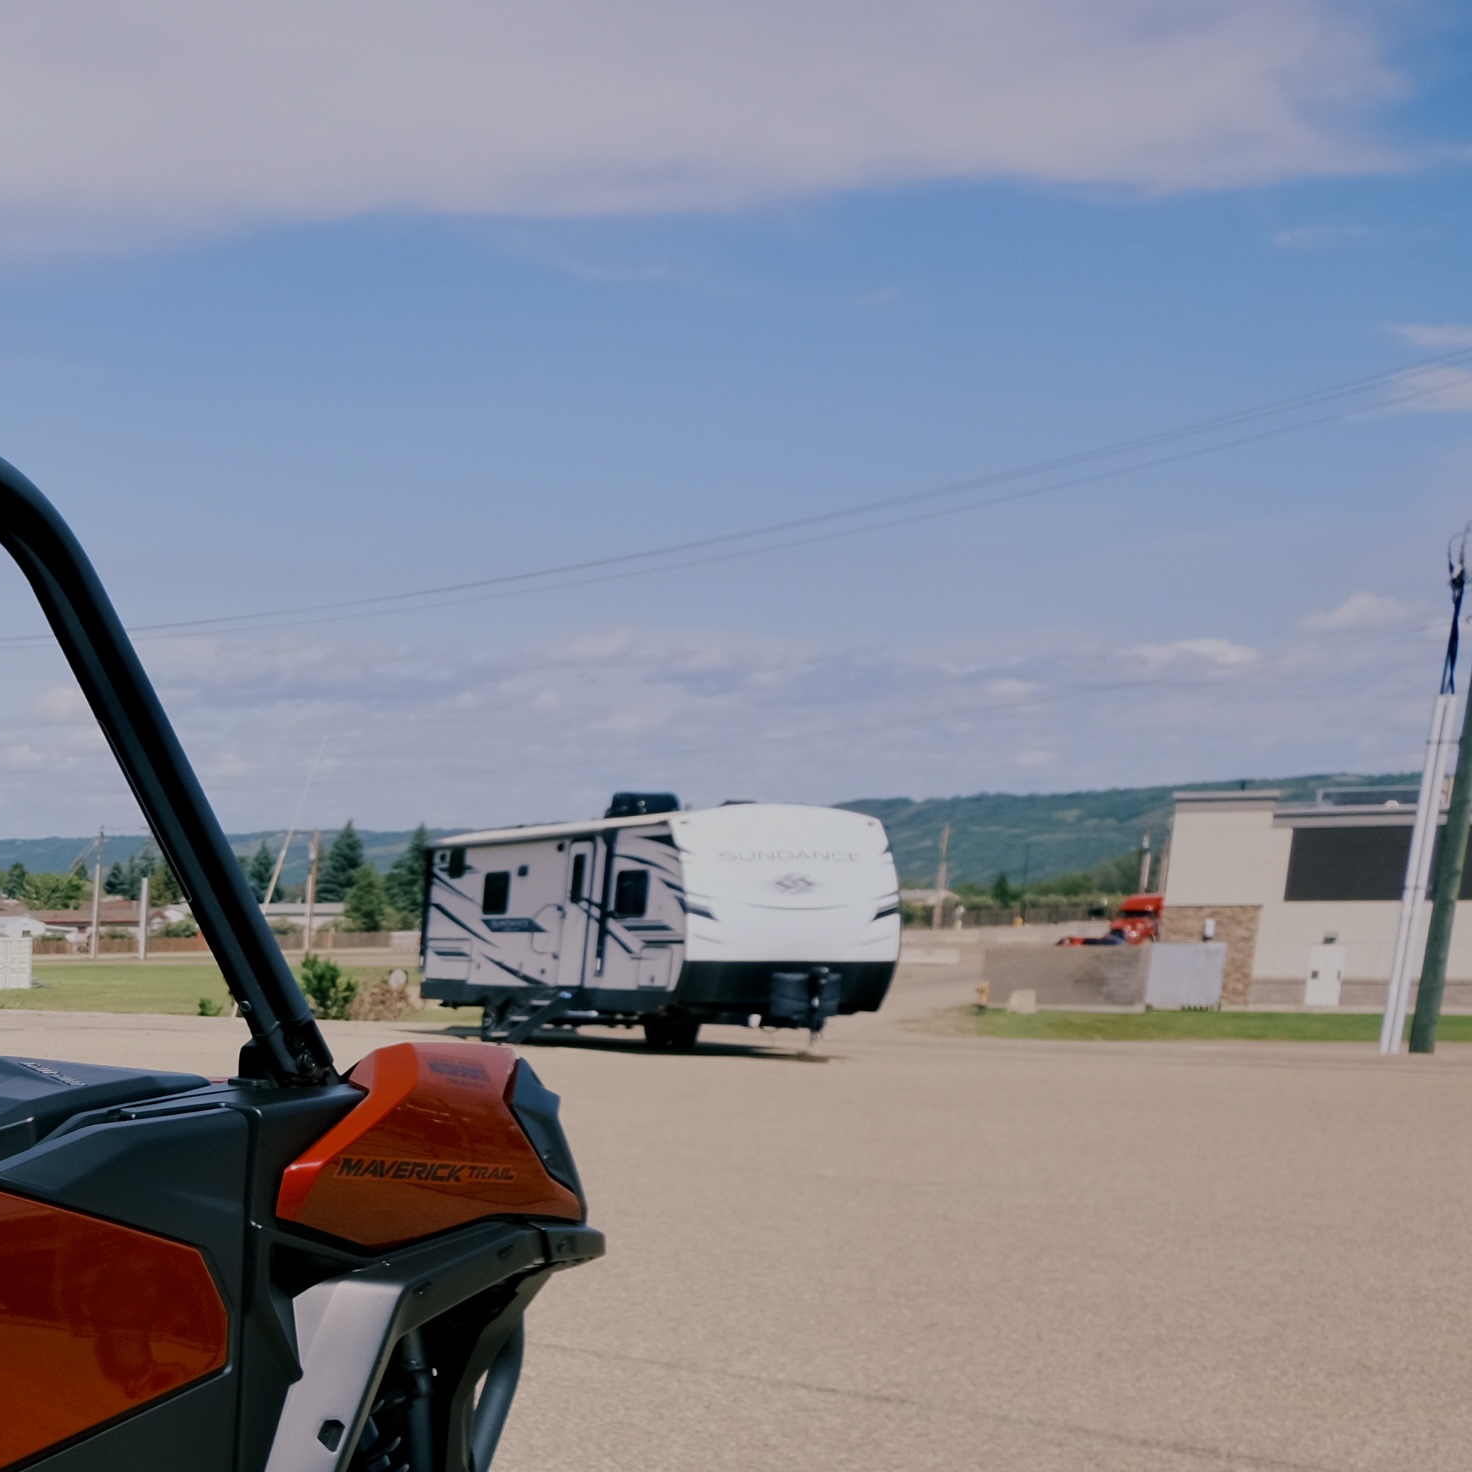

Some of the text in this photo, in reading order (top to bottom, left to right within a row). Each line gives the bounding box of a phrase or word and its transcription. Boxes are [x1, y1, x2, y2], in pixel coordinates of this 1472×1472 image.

[718, 850, 861, 863] SUNDANCE
[337, 1158, 515, 1182] MAVERICK TRAIL
